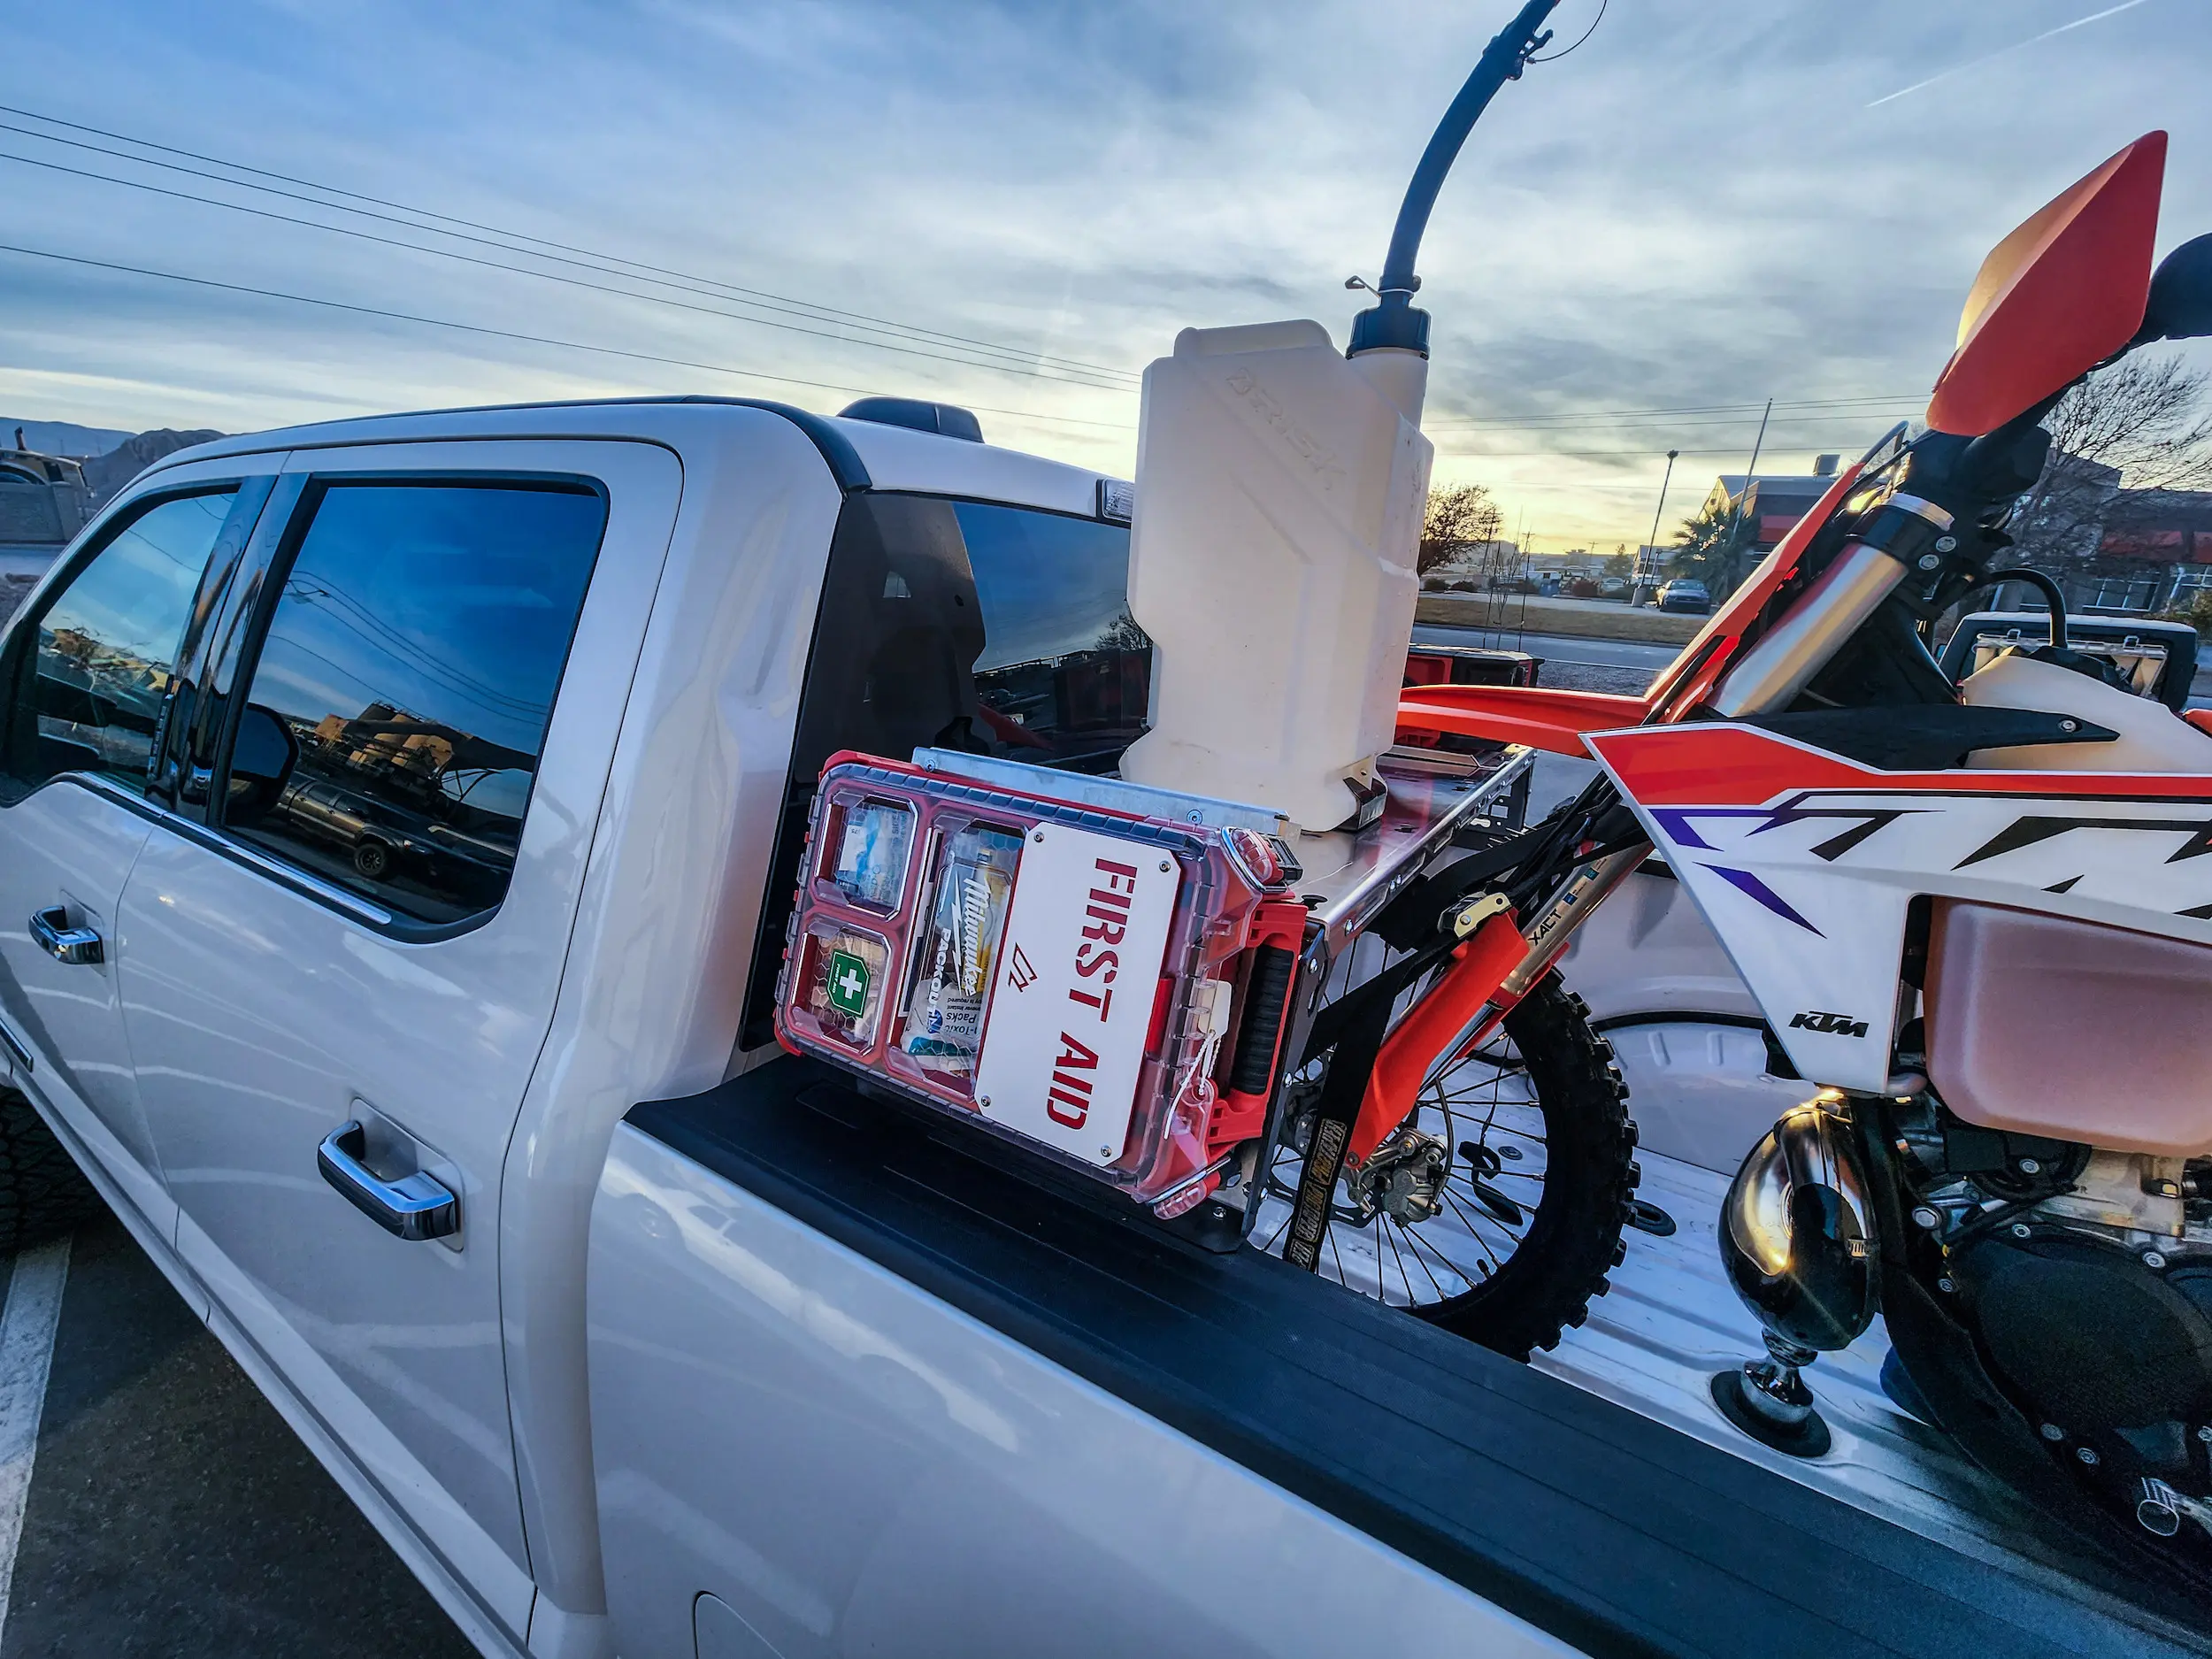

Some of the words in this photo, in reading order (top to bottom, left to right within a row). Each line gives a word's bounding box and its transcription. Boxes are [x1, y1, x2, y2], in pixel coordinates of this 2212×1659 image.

[926, 927, 952, 1018] PACKOUT
[964, 878, 991, 997] Milwaukee
[1069, 857, 1138, 1023] FIRST
[1528, 908, 1562, 946] XACT
[946, 1012, 977, 1024] Packs
[1788, 1010, 1870, 1039] KTM
[1047, 1031, 1101, 1131] AID
